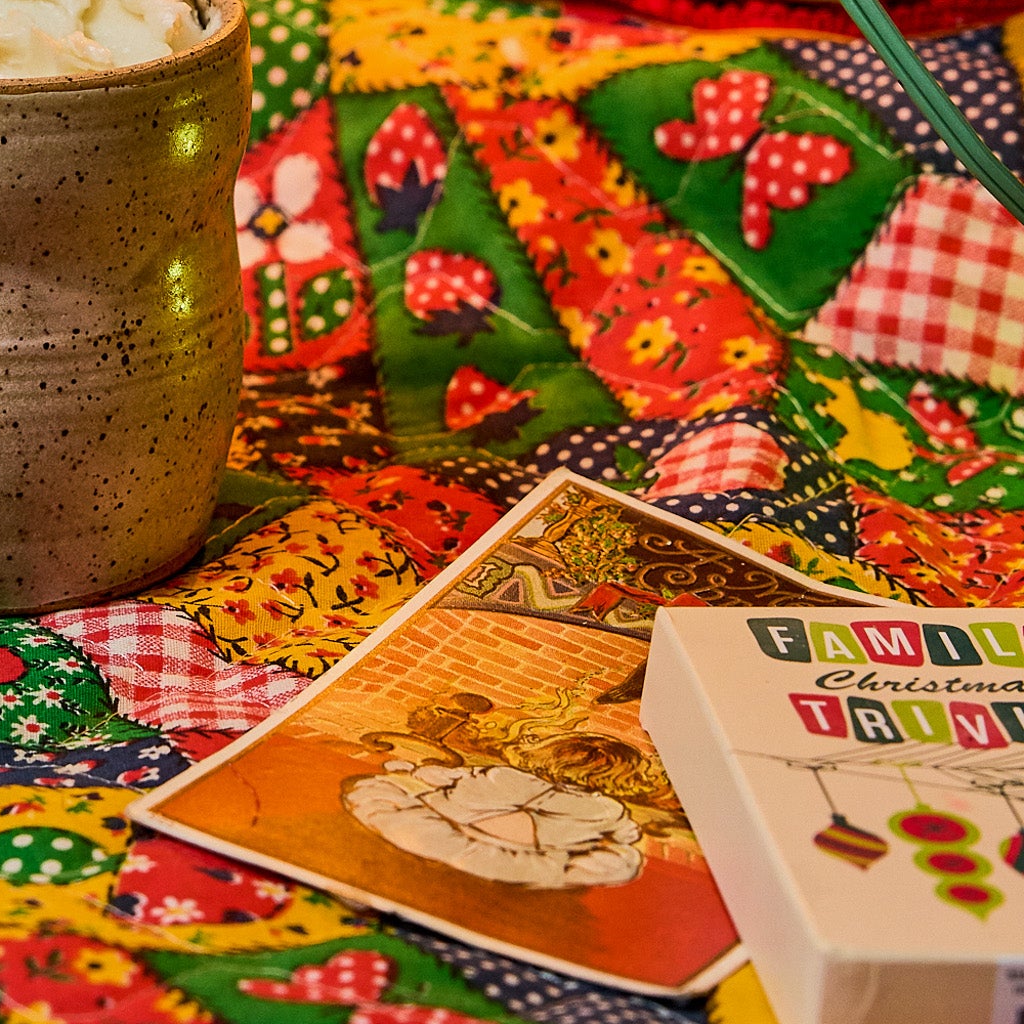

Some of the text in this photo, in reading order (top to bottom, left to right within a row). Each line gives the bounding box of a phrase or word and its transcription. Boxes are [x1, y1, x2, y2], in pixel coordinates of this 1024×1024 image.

[765, 624, 1019, 662] FAMIL
[815, 669, 1024, 693] Christma
[798, 699, 1024, 746] TRIVI
